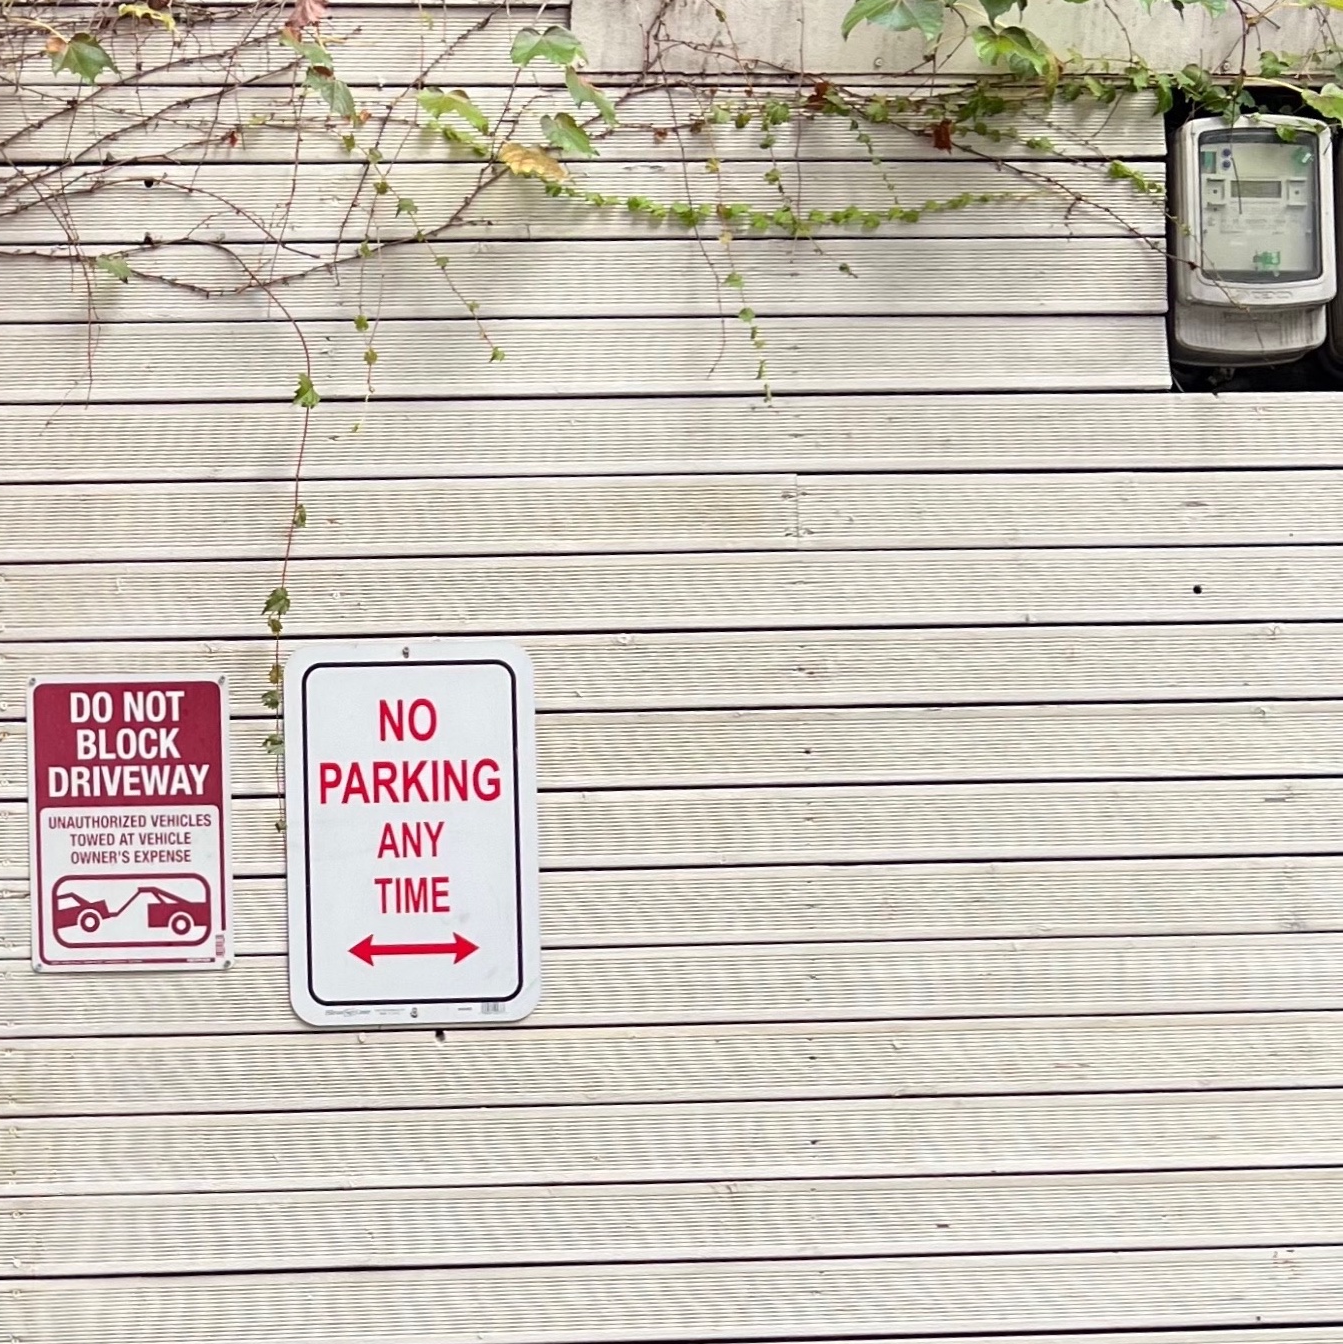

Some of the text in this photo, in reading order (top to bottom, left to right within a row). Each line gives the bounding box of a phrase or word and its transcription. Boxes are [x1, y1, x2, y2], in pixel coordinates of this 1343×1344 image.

[70, 690, 185, 724] DO NOT
[378, 697, 438, 743] NO
[76, 727, 181, 760] BLOCK
[48, 764, 210, 798] DRIVEWAY
[319, 757, 502, 805] PARKING
[48, 813, 212, 830] UNAUTHORIZED VEHICLES
[70, 831, 192, 847] TOWED AT VEHICLE
[378, 822, 445, 858] ANY
[70, 849, 192, 865] OWNER'S EXPENSE
[374, 876, 450, 914] TIME
